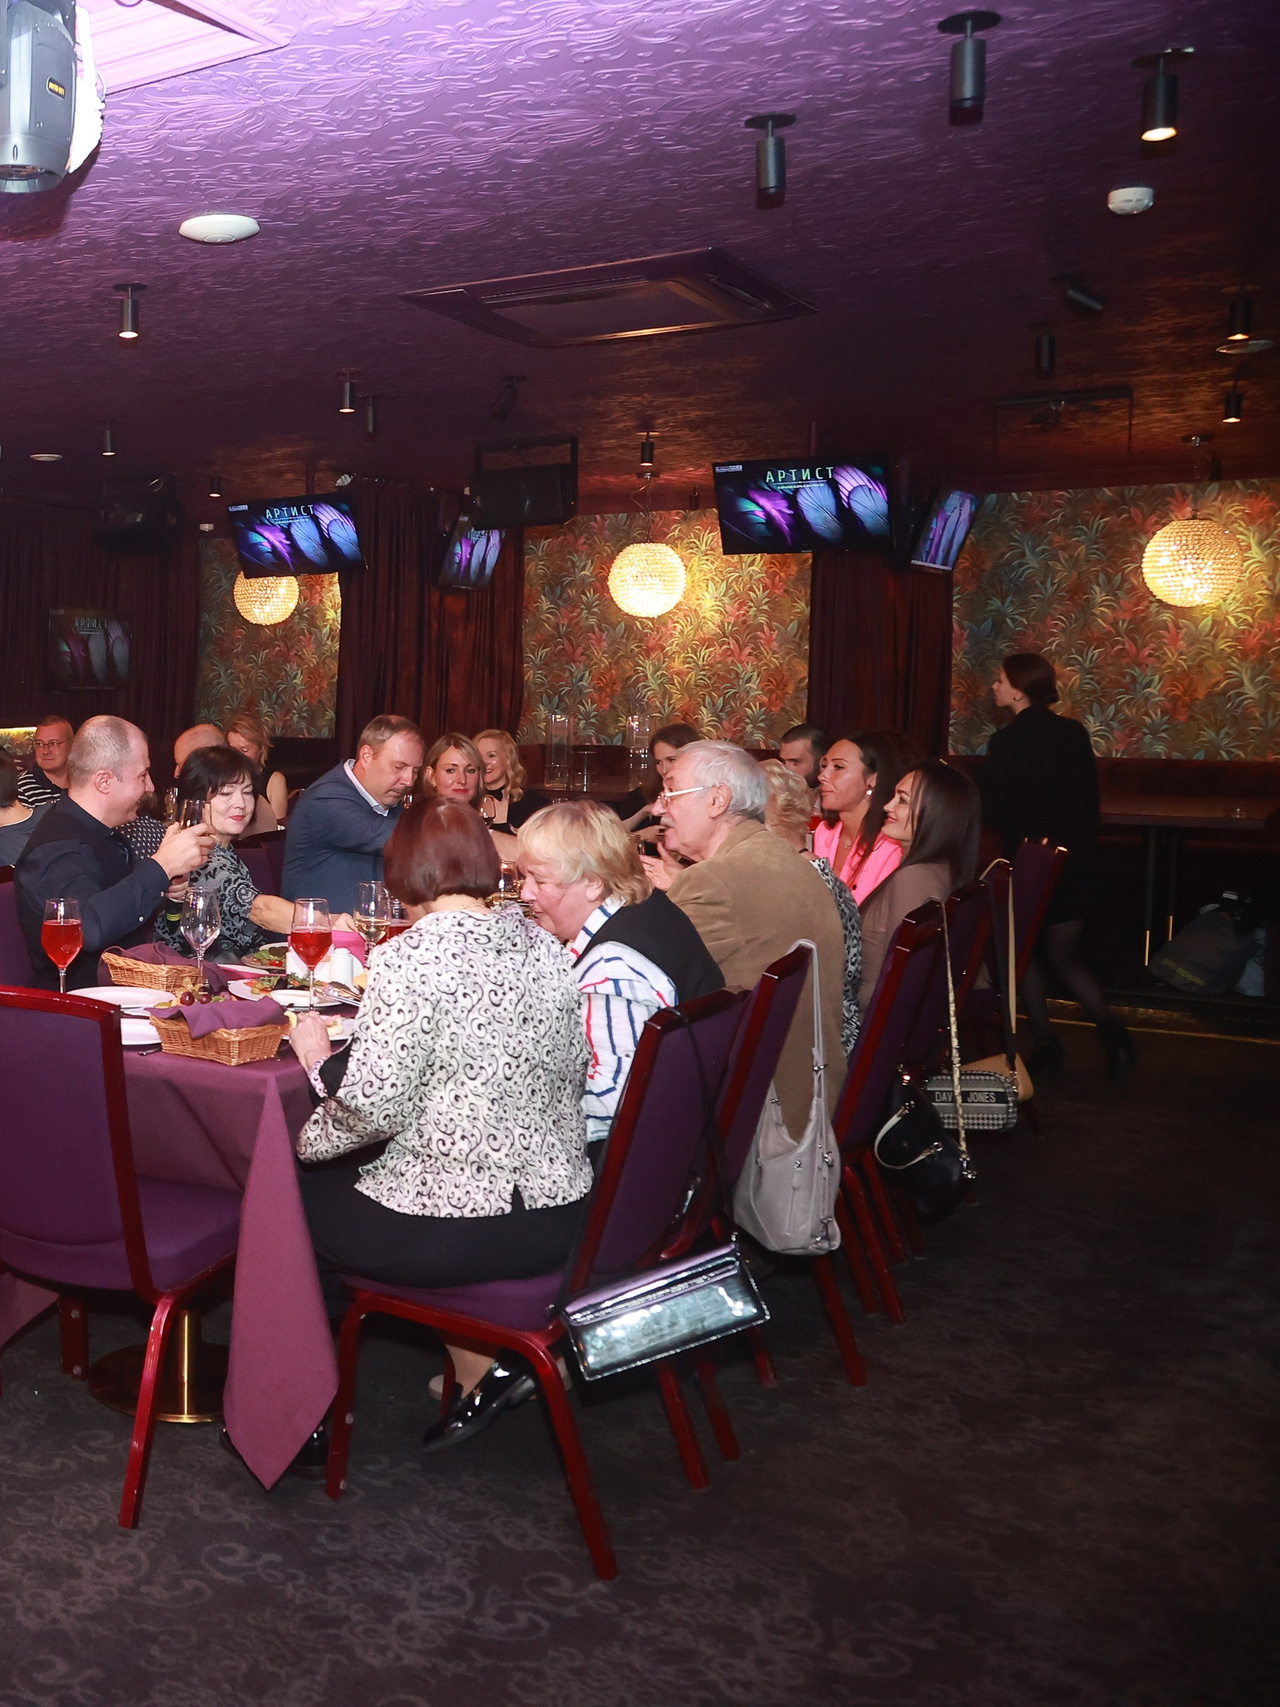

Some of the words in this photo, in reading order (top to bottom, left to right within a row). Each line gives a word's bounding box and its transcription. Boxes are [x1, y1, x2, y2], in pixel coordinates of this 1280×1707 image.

[765, 466, 834, 483] АРТИСТ
[265, 504, 314, 519] АРТИСТ
[934, 1091, 961, 1102] DAV
[967, 1091, 996, 1103] JONES
